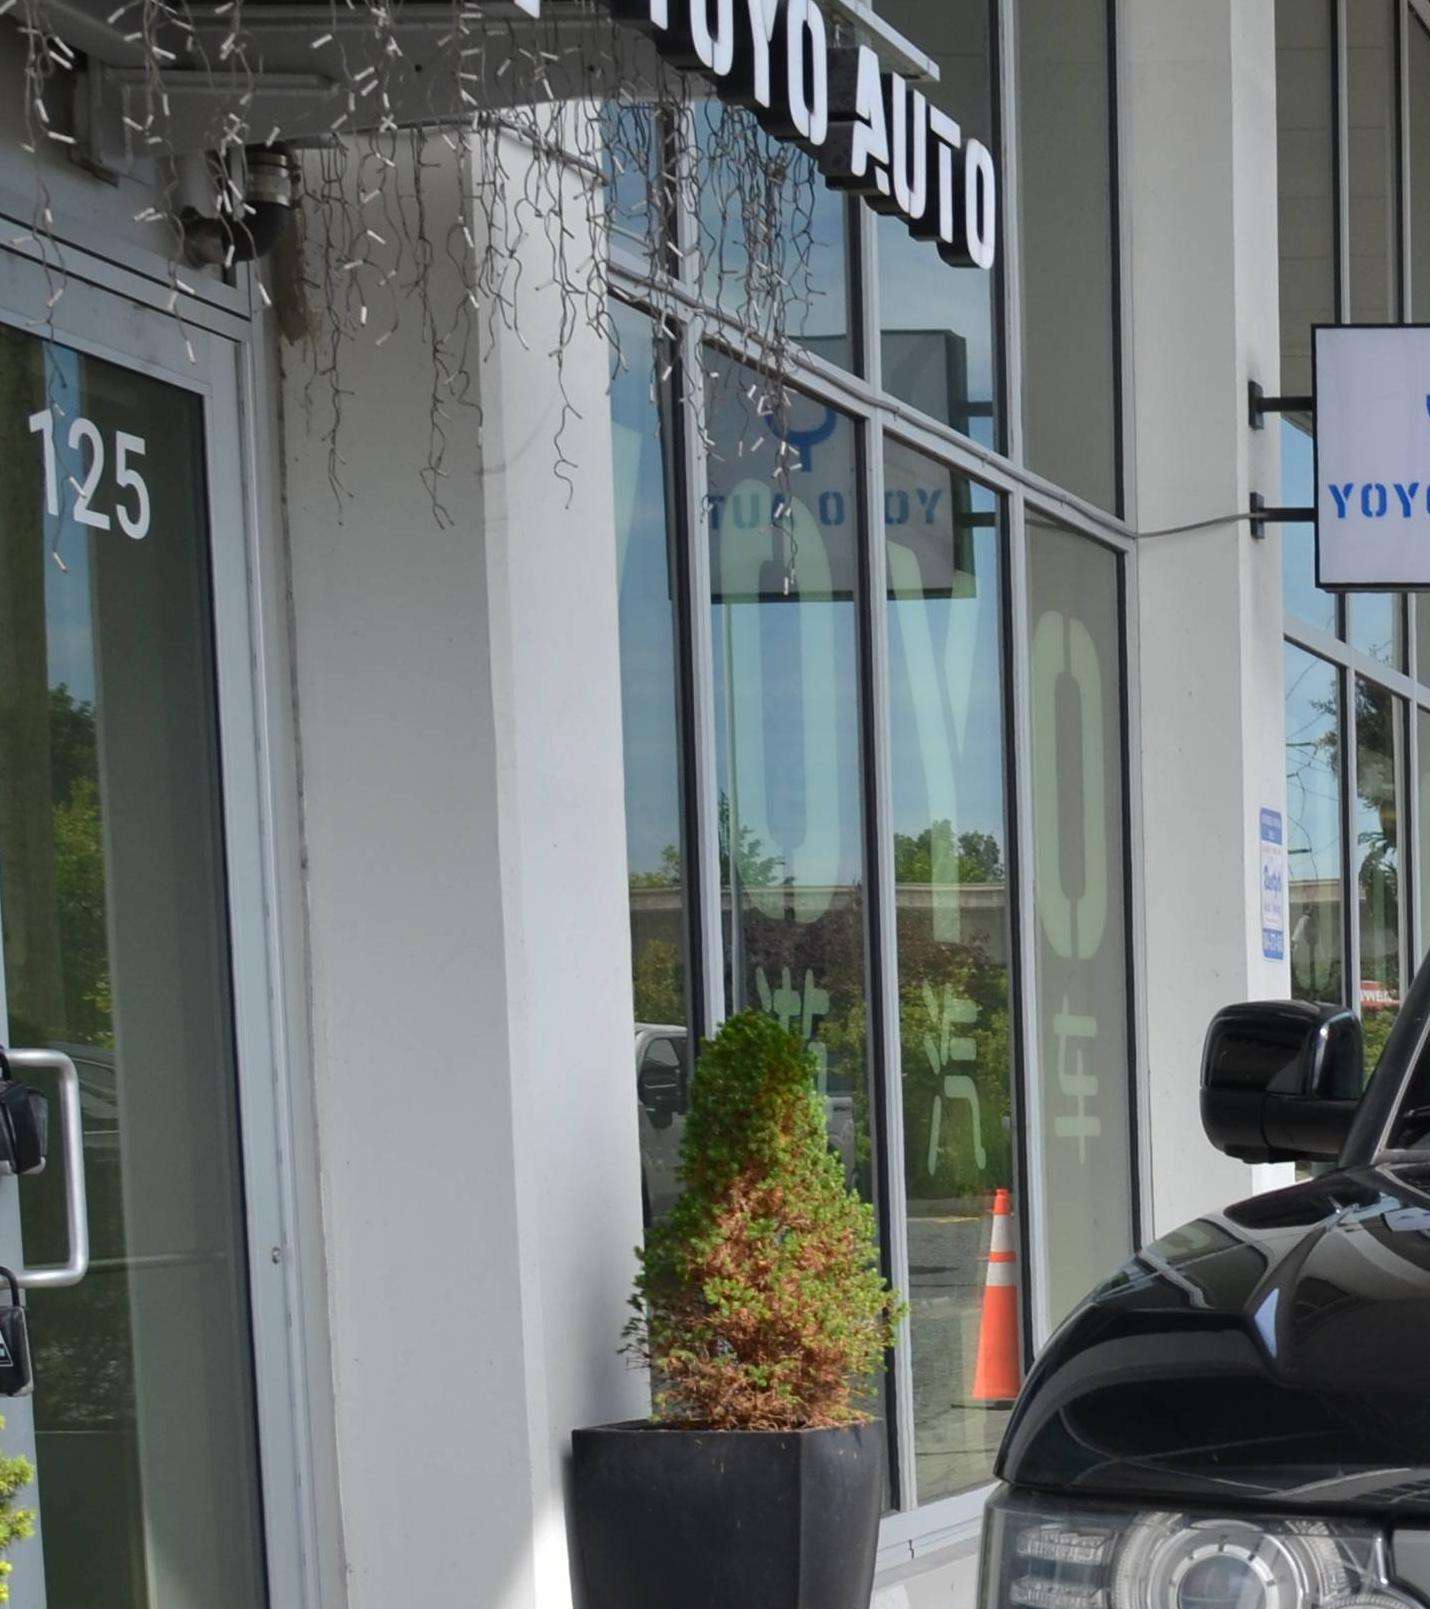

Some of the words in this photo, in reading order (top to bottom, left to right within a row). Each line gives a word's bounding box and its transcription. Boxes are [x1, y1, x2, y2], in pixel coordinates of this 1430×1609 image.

[650, 0, 827, 145] OYO
[851, 44, 996, 270] AUTO
[29, 408, 149, 540] 125
